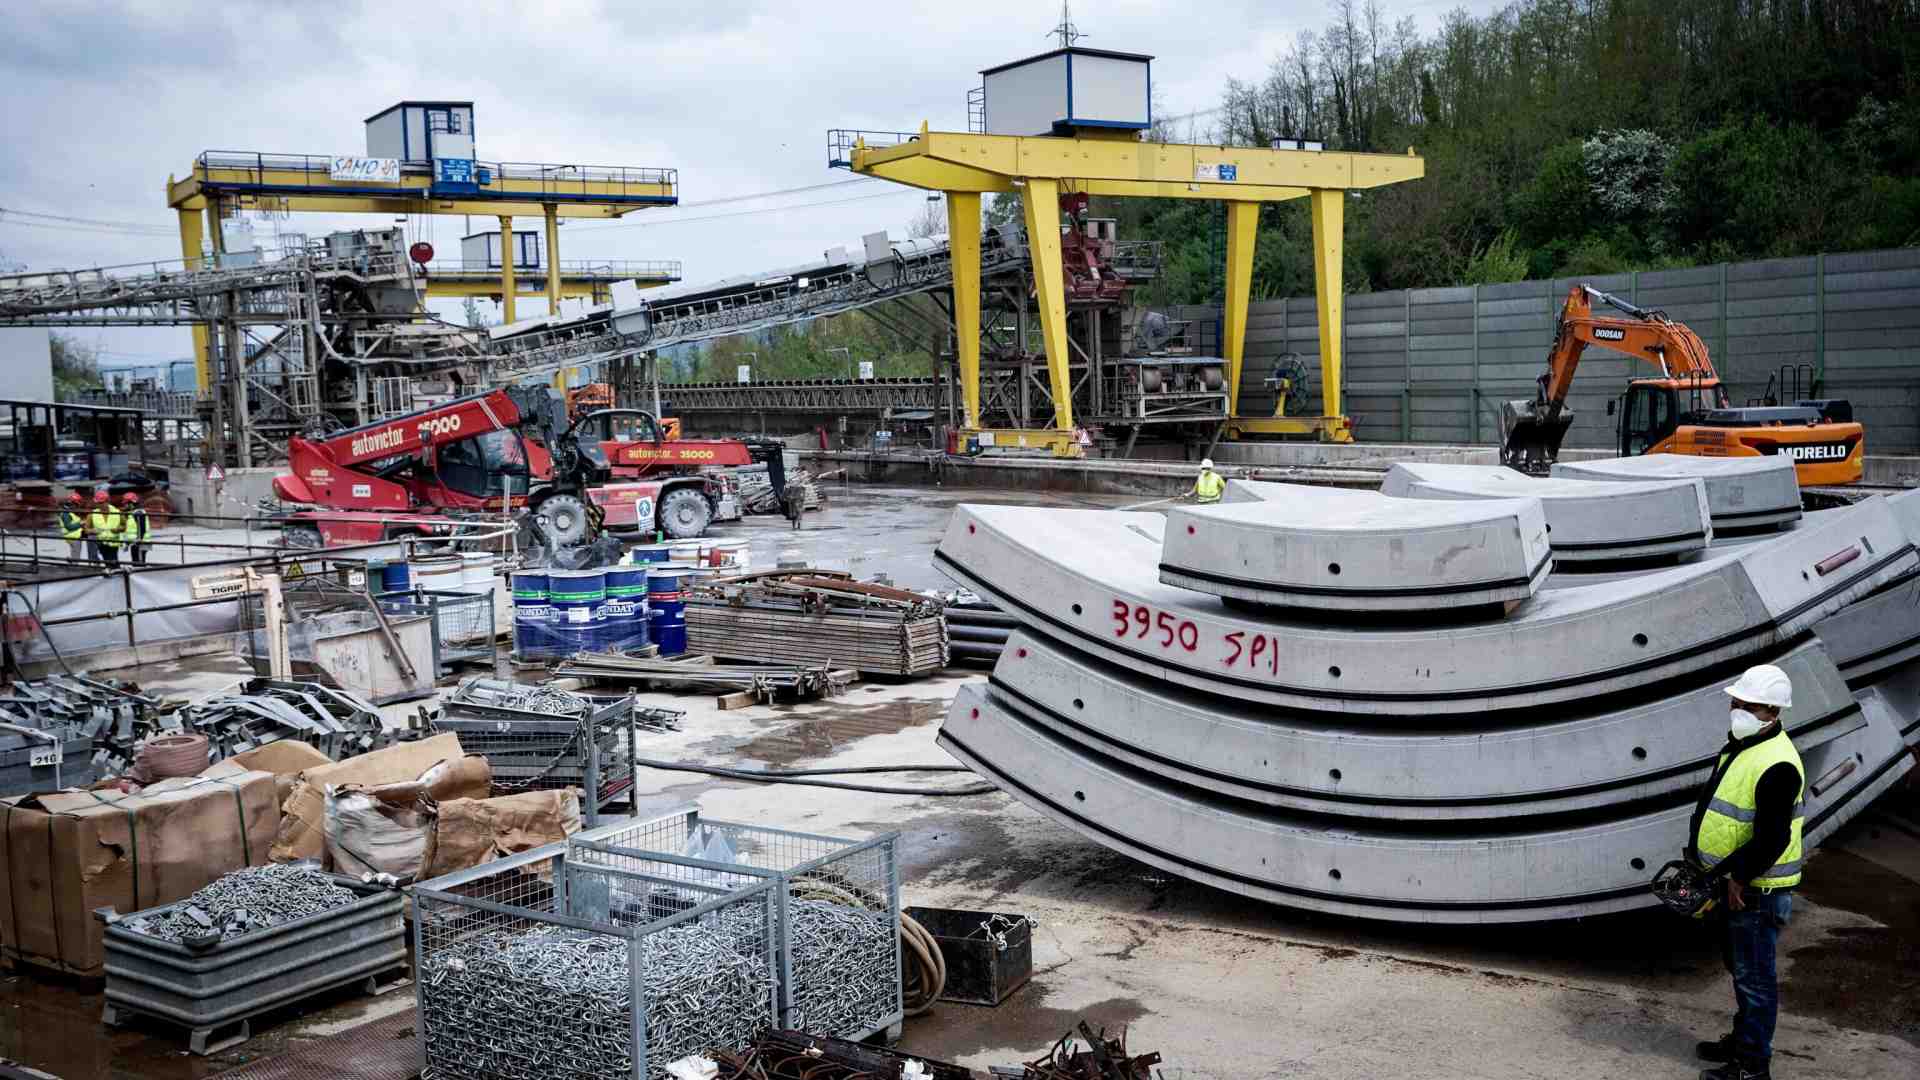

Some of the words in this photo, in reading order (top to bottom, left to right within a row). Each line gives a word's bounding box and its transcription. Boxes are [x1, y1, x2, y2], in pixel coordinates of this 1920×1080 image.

[1594, 329, 1624, 339] DOOSAN
[352, 427, 404, 456] autovictor
[1777, 445, 1847, 459] MORELLO
[210, 584, 243, 595] TIGRIP
[1112, 599, 1199, 652] 3950
